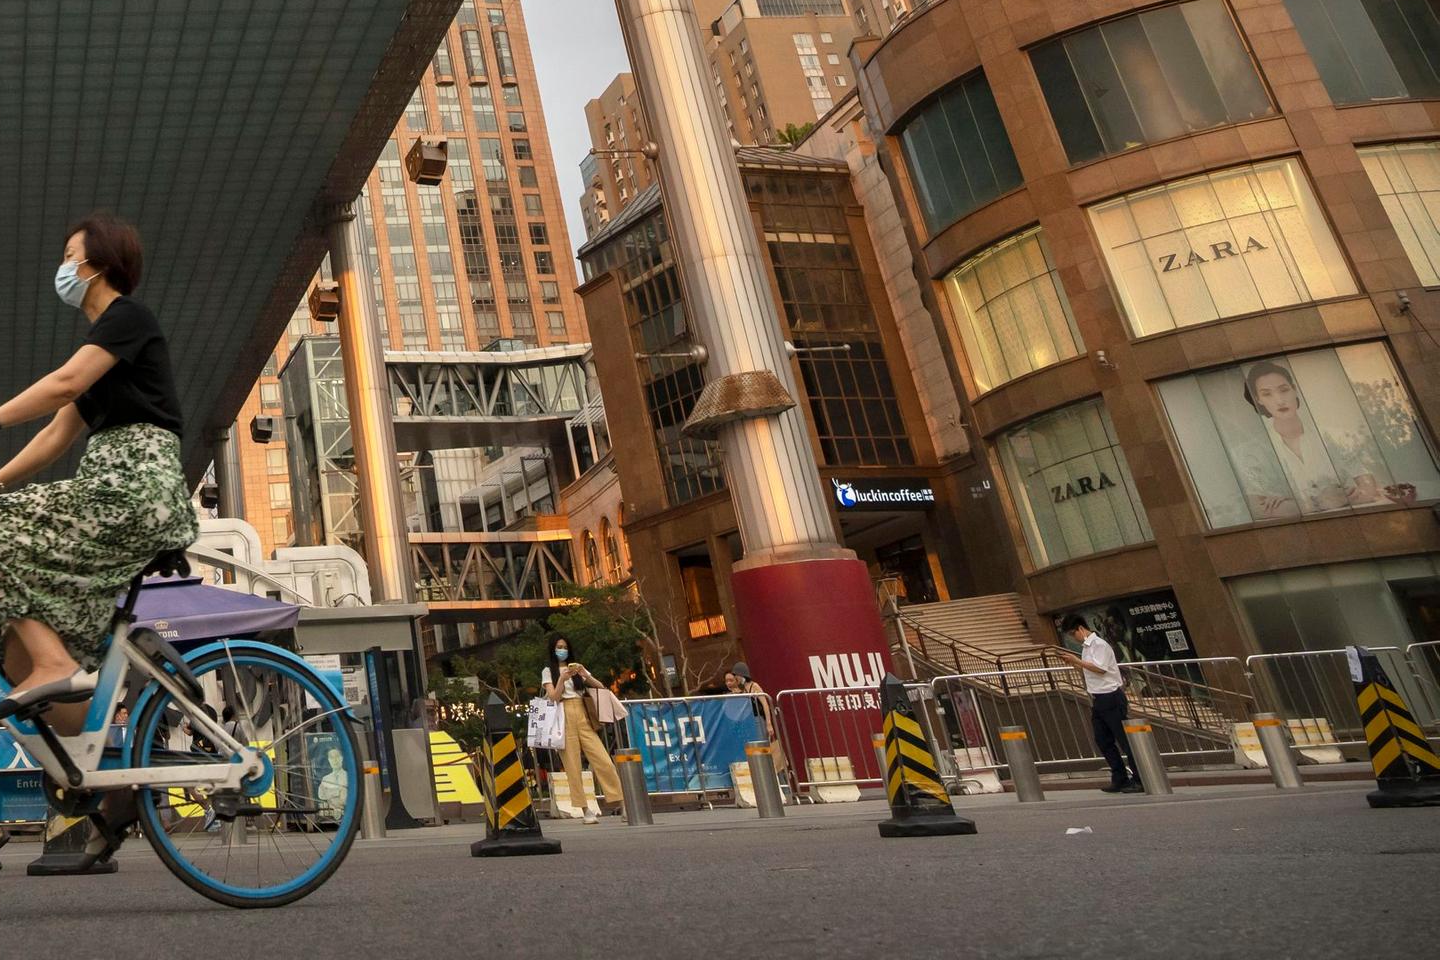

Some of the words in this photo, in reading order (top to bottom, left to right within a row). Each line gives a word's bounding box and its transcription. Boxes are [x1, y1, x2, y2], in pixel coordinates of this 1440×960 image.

[1158, 236, 1269, 273] ZARA
[855, 489, 924, 502] luckincoffee
[1051, 472, 1117, 504] ZARA
[159, 629, 180, 639] rona
[808, 652, 887, 689] MUJI
[642, 715, 707, 748] 出口
[668, 753, 689, 762] Ext
